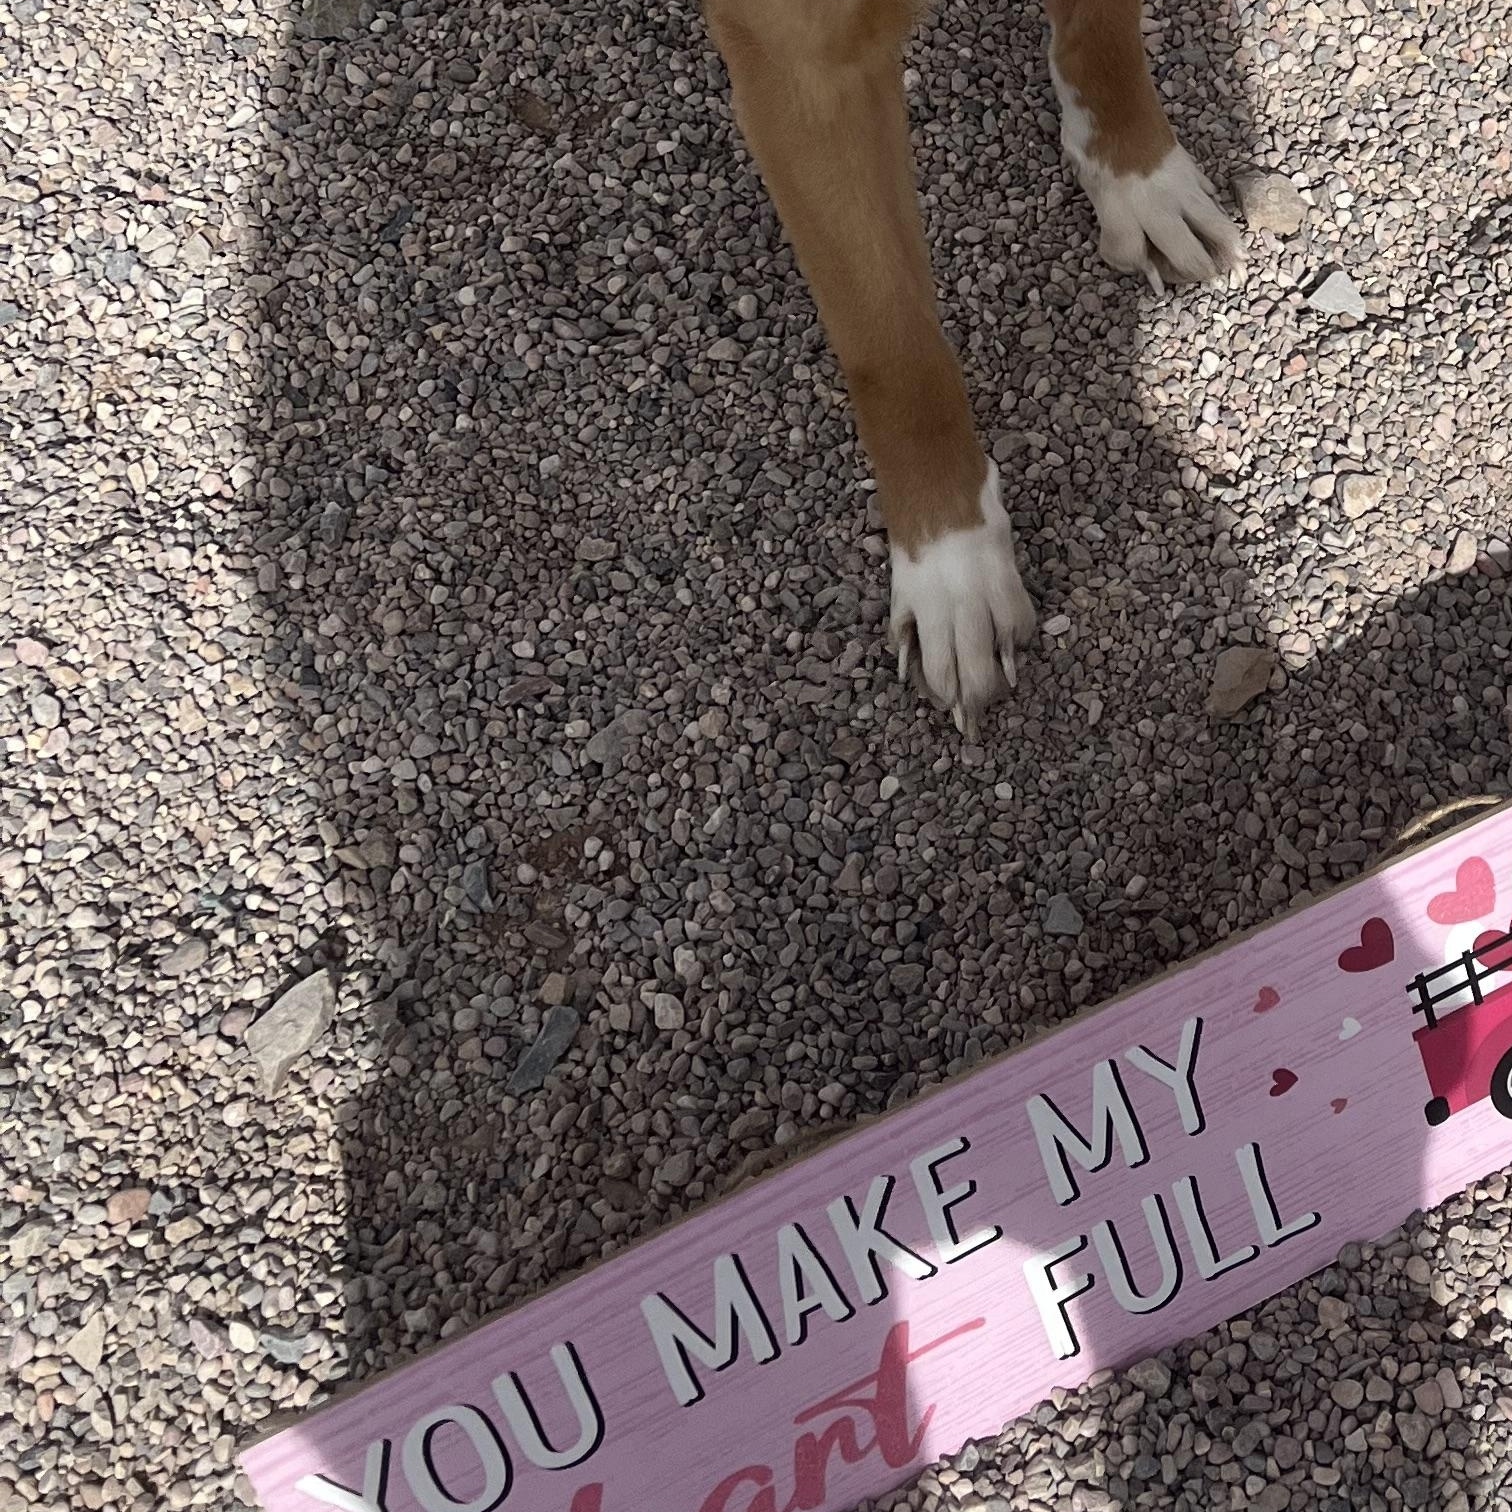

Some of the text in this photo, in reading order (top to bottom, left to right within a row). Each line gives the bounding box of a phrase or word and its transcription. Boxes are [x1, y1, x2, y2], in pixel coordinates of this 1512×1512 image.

[296, 1017, 1205, 1512] YOU MAKE MY
[1022, 1142, 1321, 1360] FULL
